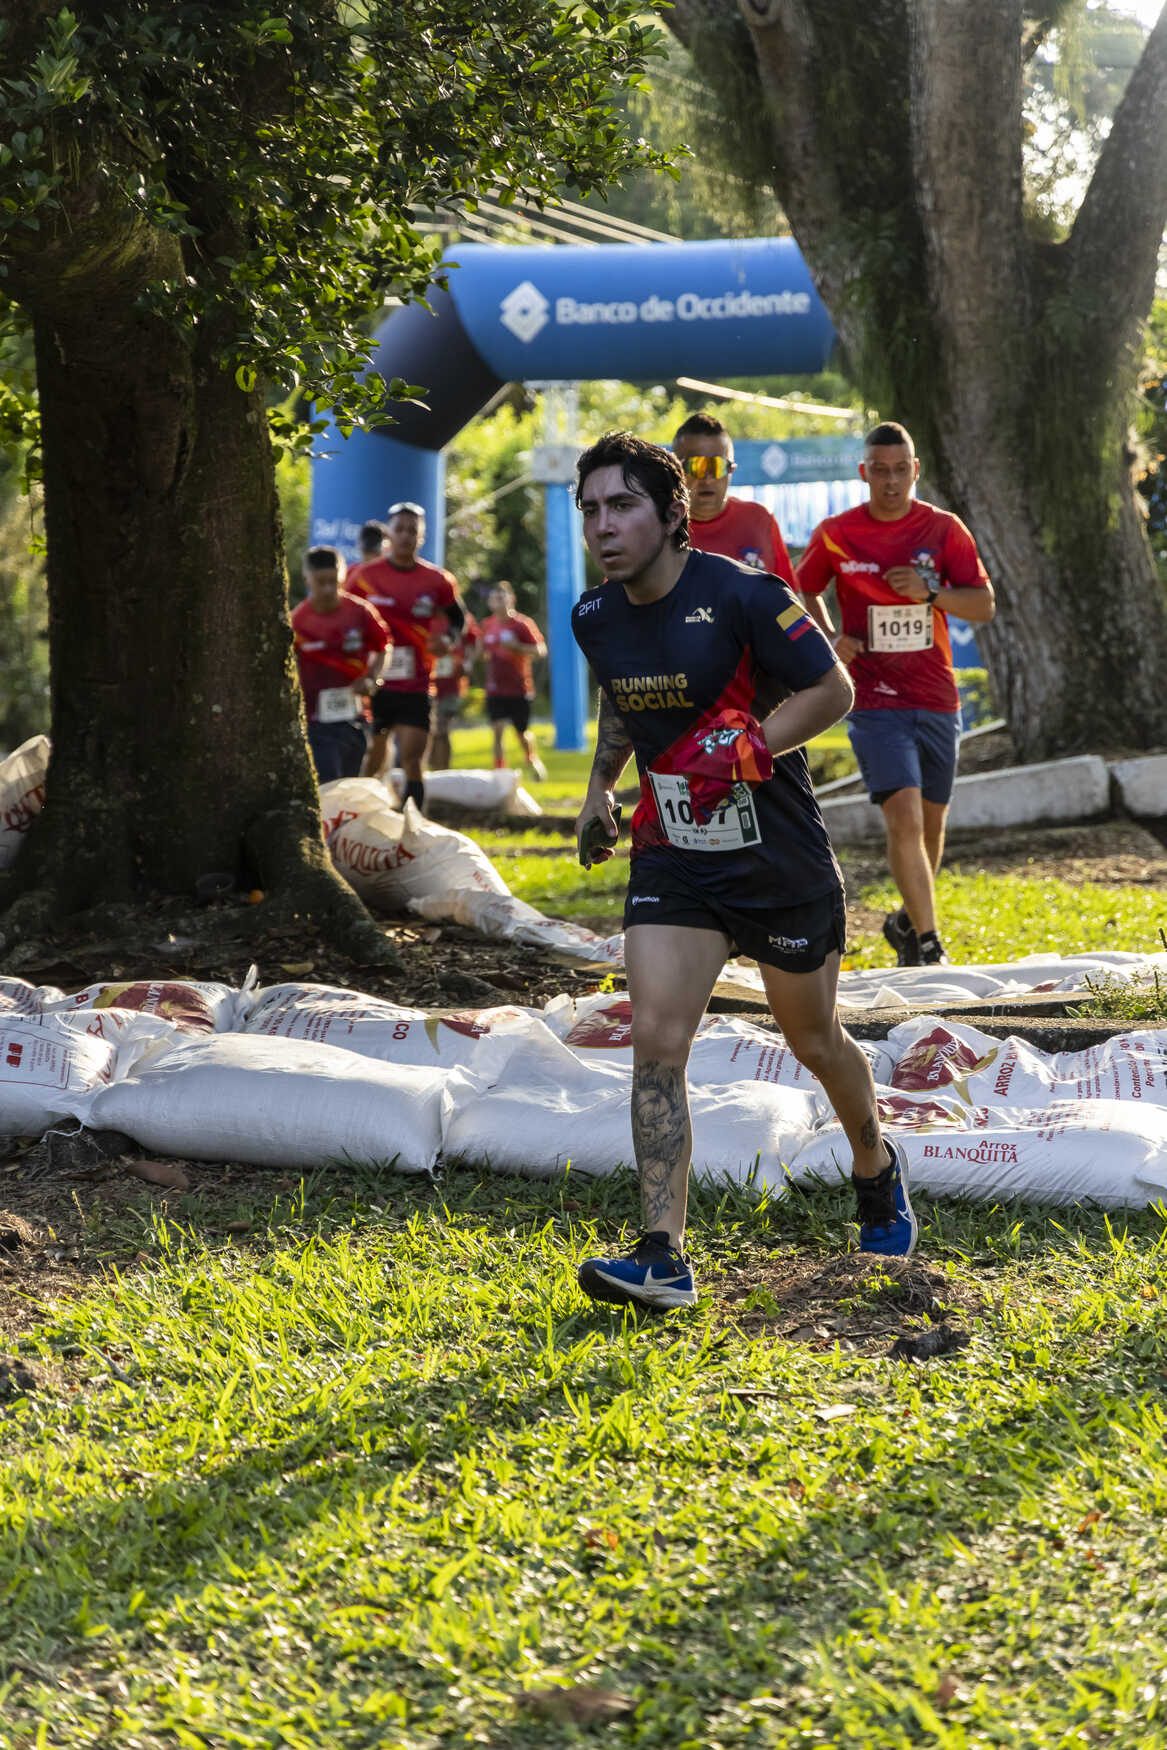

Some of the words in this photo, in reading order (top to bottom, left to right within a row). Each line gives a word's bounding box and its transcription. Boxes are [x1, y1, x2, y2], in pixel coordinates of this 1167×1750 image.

[556, 297, 638, 325] Banco
[640, 295, 674, 322] de
[676, 290, 811, 320] Occidente
[578, 598, 603, 616] 2FIT
[878, 620, 924, 637] 1019
[610, 672, 689, 695] RUNNING
[615, 690, 695, 713] SOCIAL
[664, 798, 727, 826] 10
[993, 1060, 1018, 1098] ARROZ
[923, 1145, 1018, 1165] BLANQUITA
[978, 1139, 1018, 1150] Arroz
